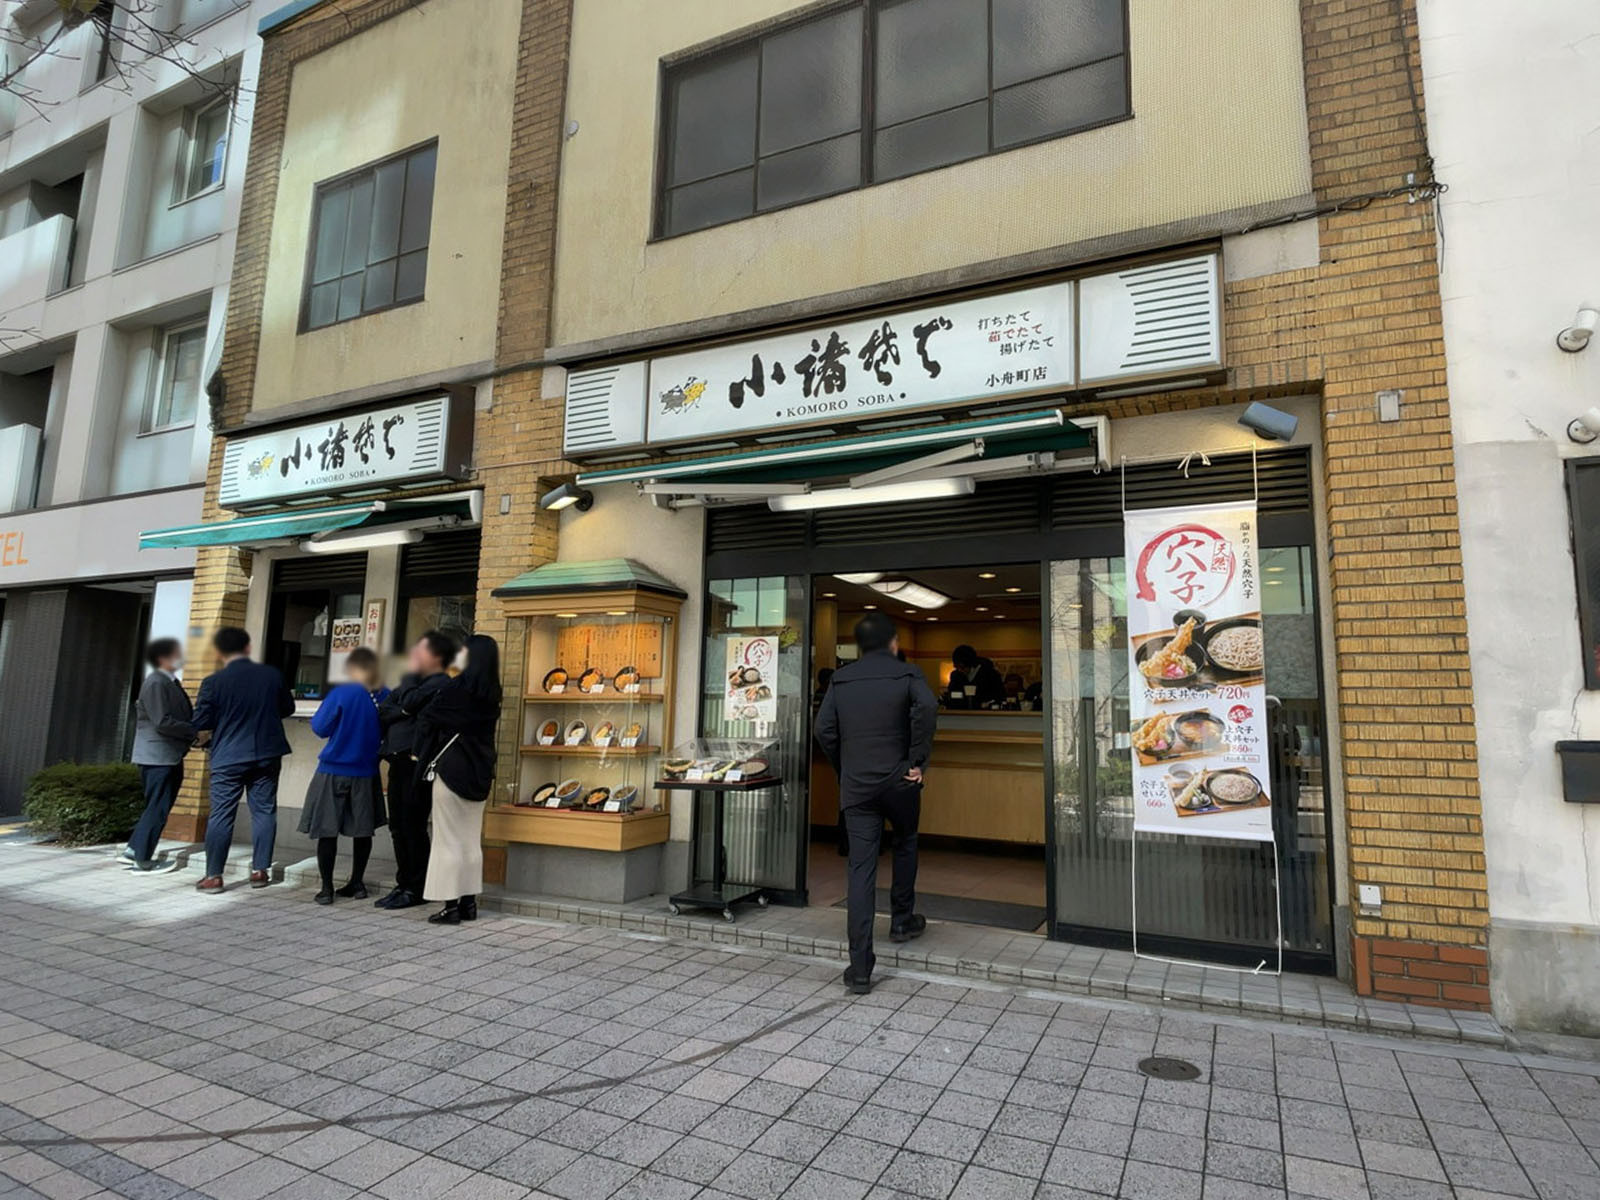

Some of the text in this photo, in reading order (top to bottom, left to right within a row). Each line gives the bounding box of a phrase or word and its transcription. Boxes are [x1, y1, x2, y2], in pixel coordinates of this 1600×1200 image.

[978, 311, 1030, 330] 打ちたて
[988, 323, 1042, 342] 茹でたて
[1000, 336, 1054, 356] 揚げたて
[985, 366, 1047, 387] 小舟町店
[787, 394, 895, 417] KOMORO SOBA
[310, 470, 371, 485] KOMORO SOBA
[0, 532, 29, 567] EL
[1211, 542, 1231, 572] 天然
[1165, 534, 1207, 604] 穴子
